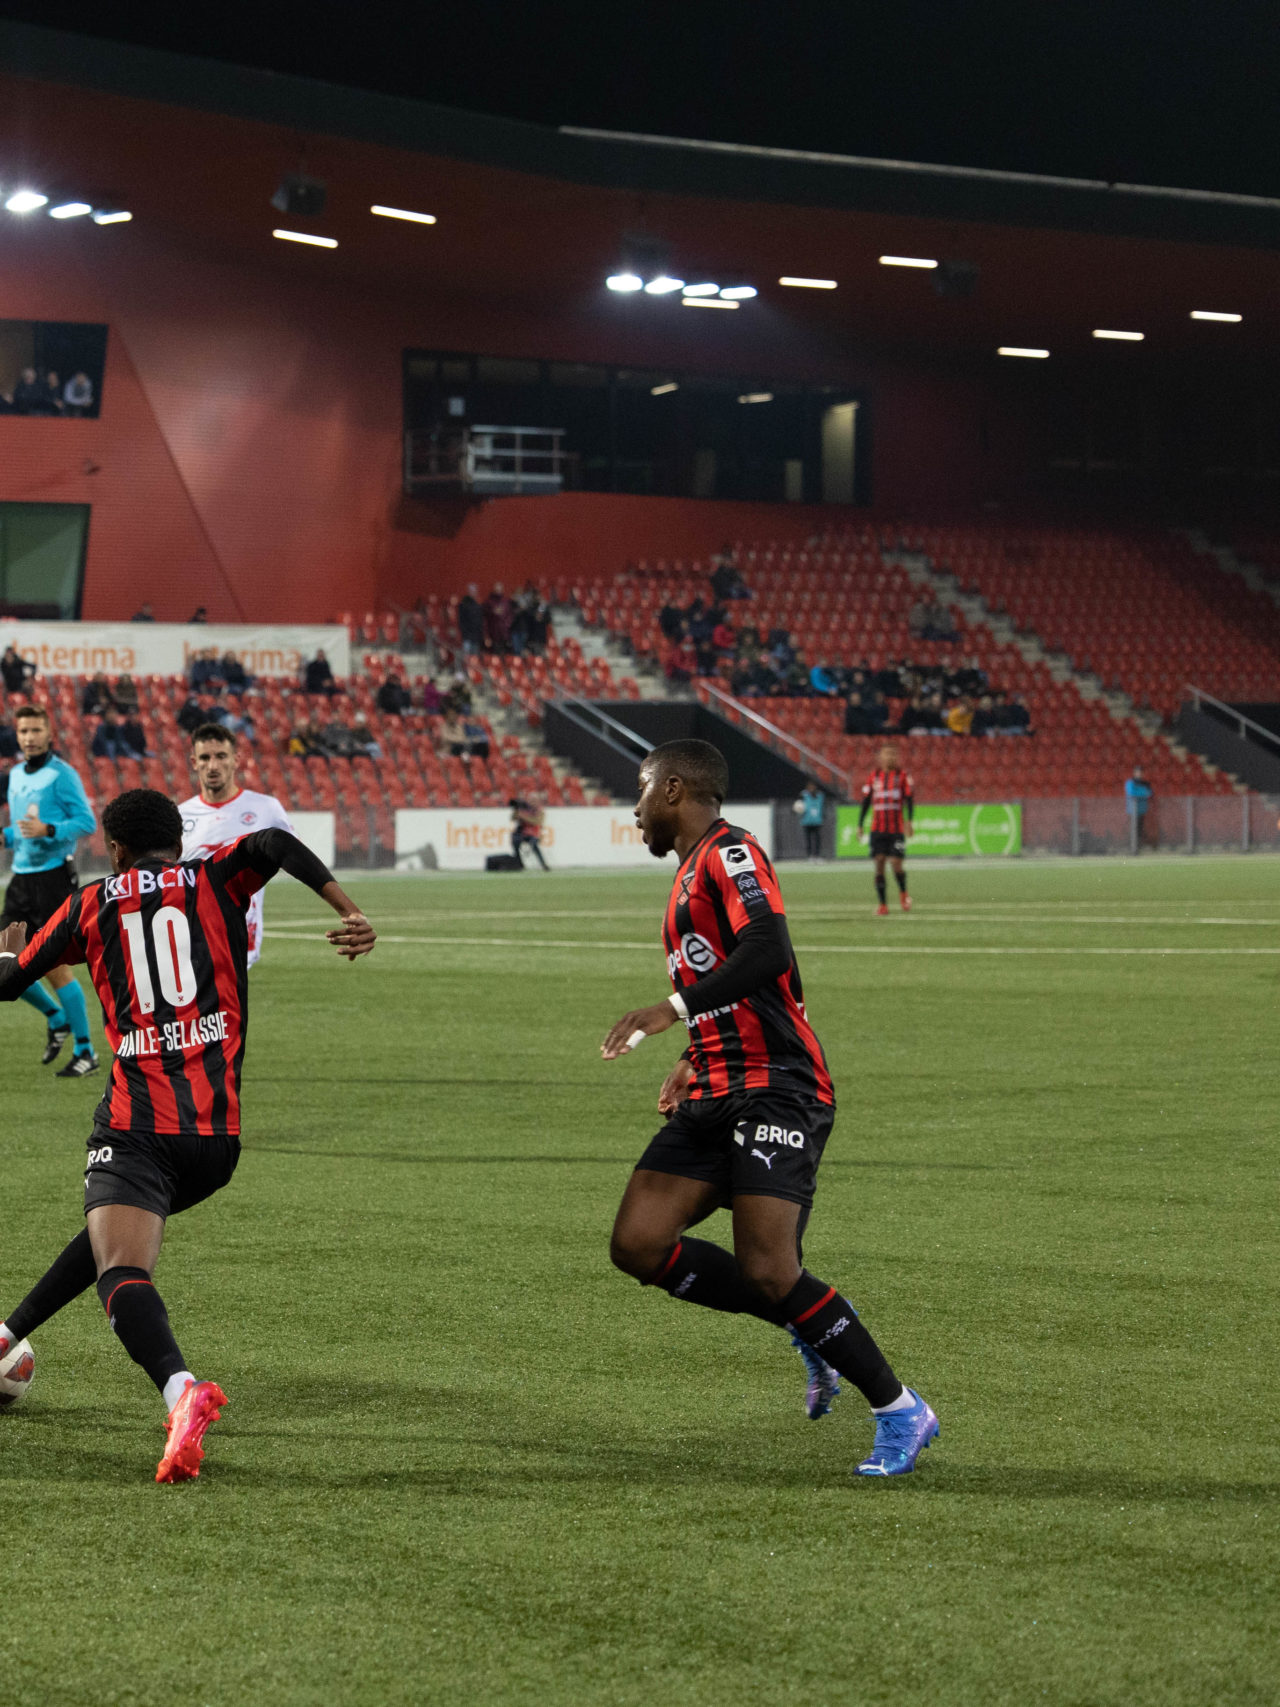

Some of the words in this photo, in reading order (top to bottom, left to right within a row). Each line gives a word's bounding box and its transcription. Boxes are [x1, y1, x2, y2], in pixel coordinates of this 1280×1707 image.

[182, 640, 302, 672] Irima
[446, 820, 555, 848] Intera
[138, 868, 196, 894] BCN
[121, 906, 198, 1015] 10
[117, 1011, 229, 1058] HAILE-SELASSIE
[755, 1124, 804, 1149] BRIQ
